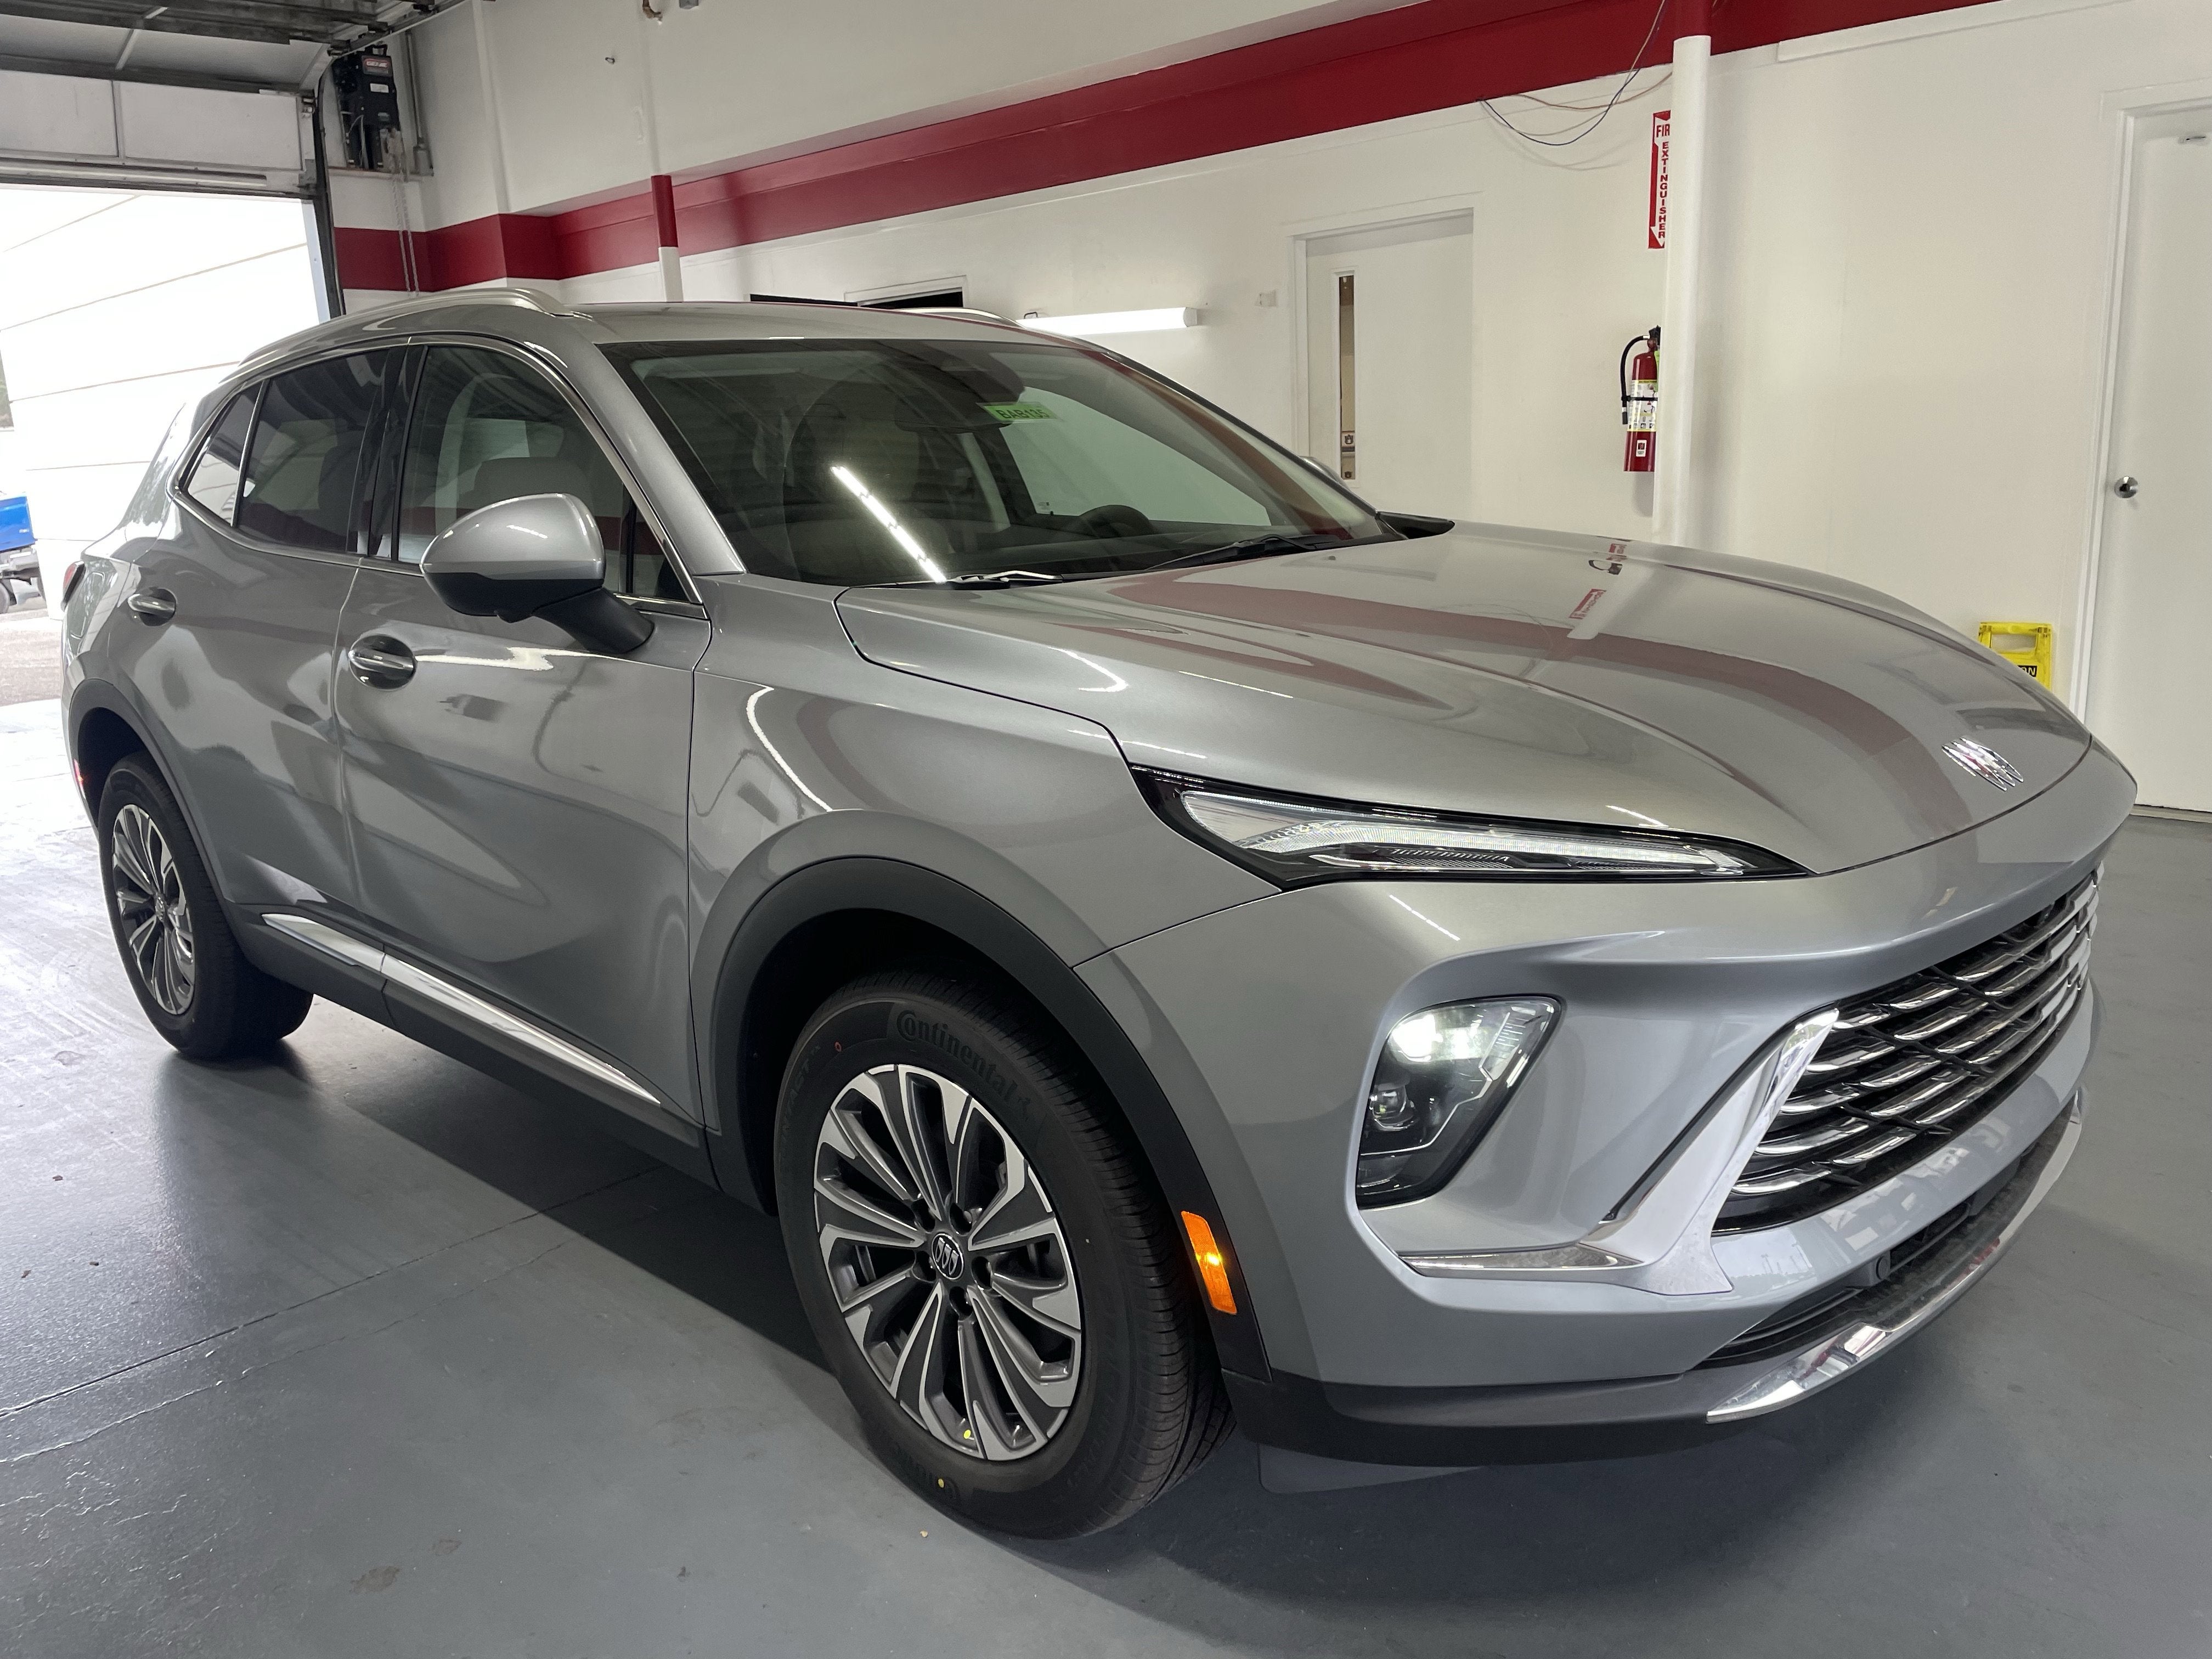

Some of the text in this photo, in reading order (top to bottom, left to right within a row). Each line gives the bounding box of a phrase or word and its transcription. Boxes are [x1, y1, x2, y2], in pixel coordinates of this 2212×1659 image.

[1656, 123, 1670, 138] FIR
[1658, 141, 1669, 239] EXTINGUISHER
[996, 409, 1050, 419] BAB135
[896, 1009, 1018, 1101] Continental
